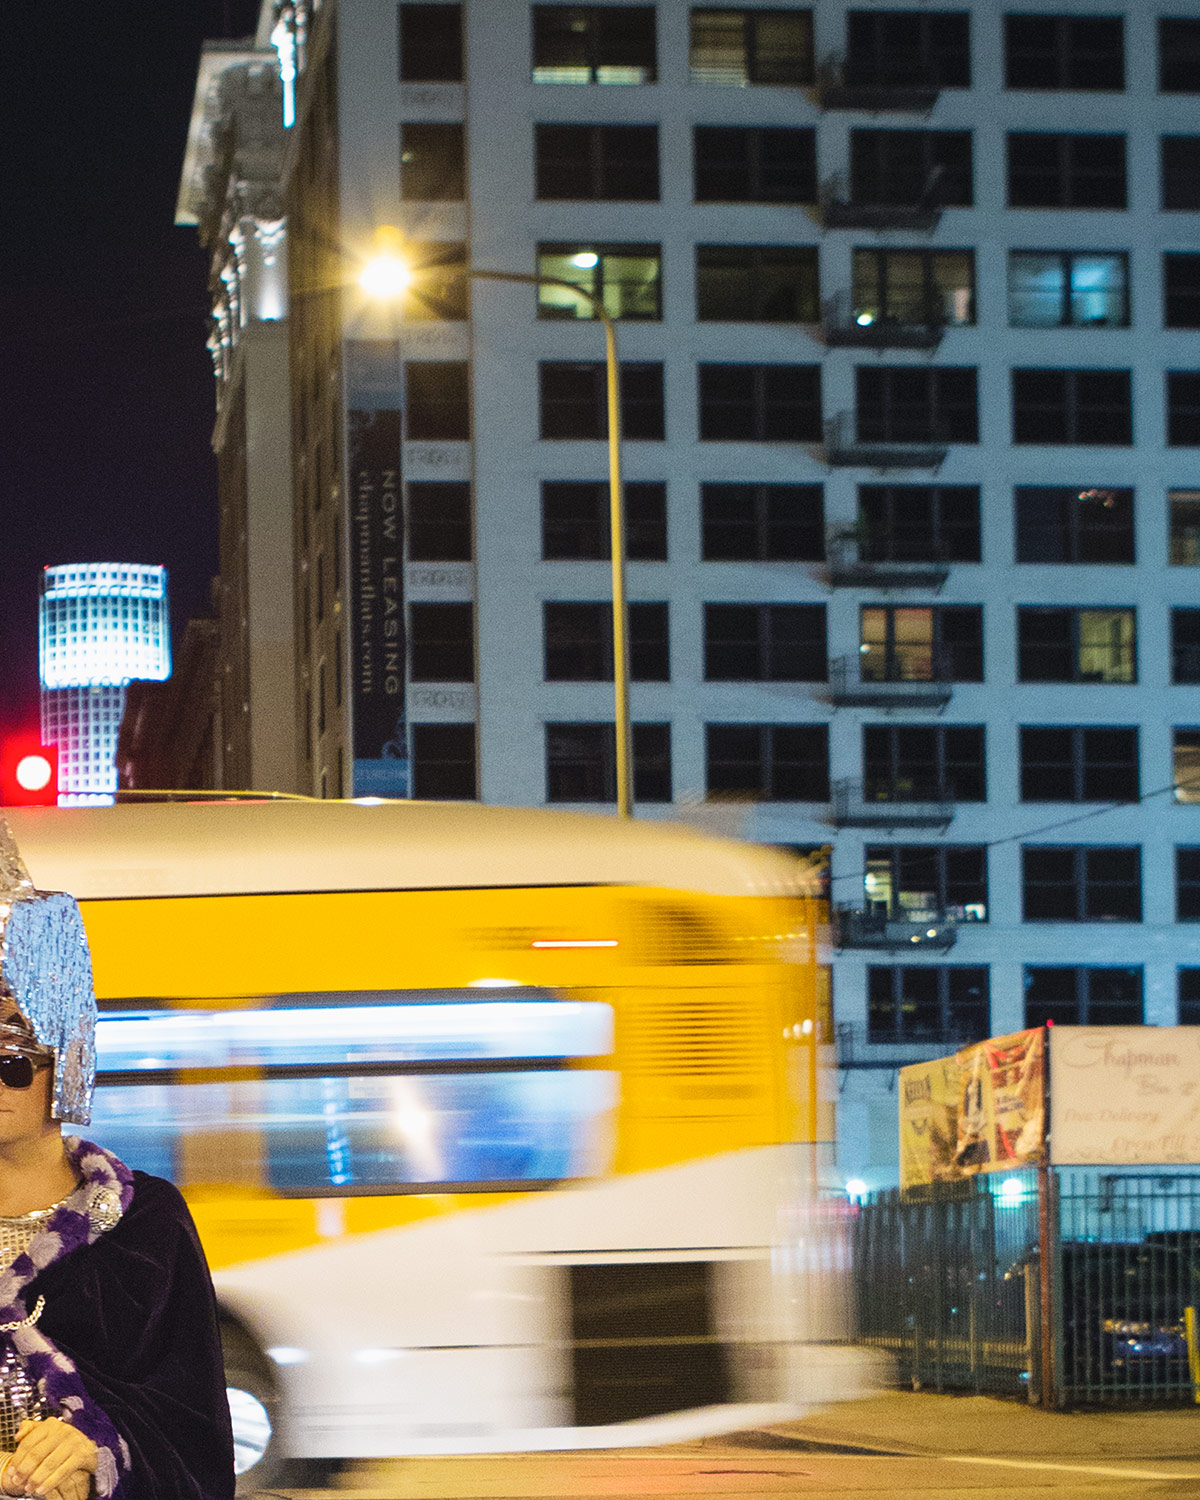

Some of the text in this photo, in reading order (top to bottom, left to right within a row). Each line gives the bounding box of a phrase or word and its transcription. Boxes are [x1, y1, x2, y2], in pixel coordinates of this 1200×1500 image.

[354, 470, 377, 694] chapmanflats.com
[381, 470, 400, 695] NOW LEASING
[1060, 1029, 1180, 1079] Chapman
